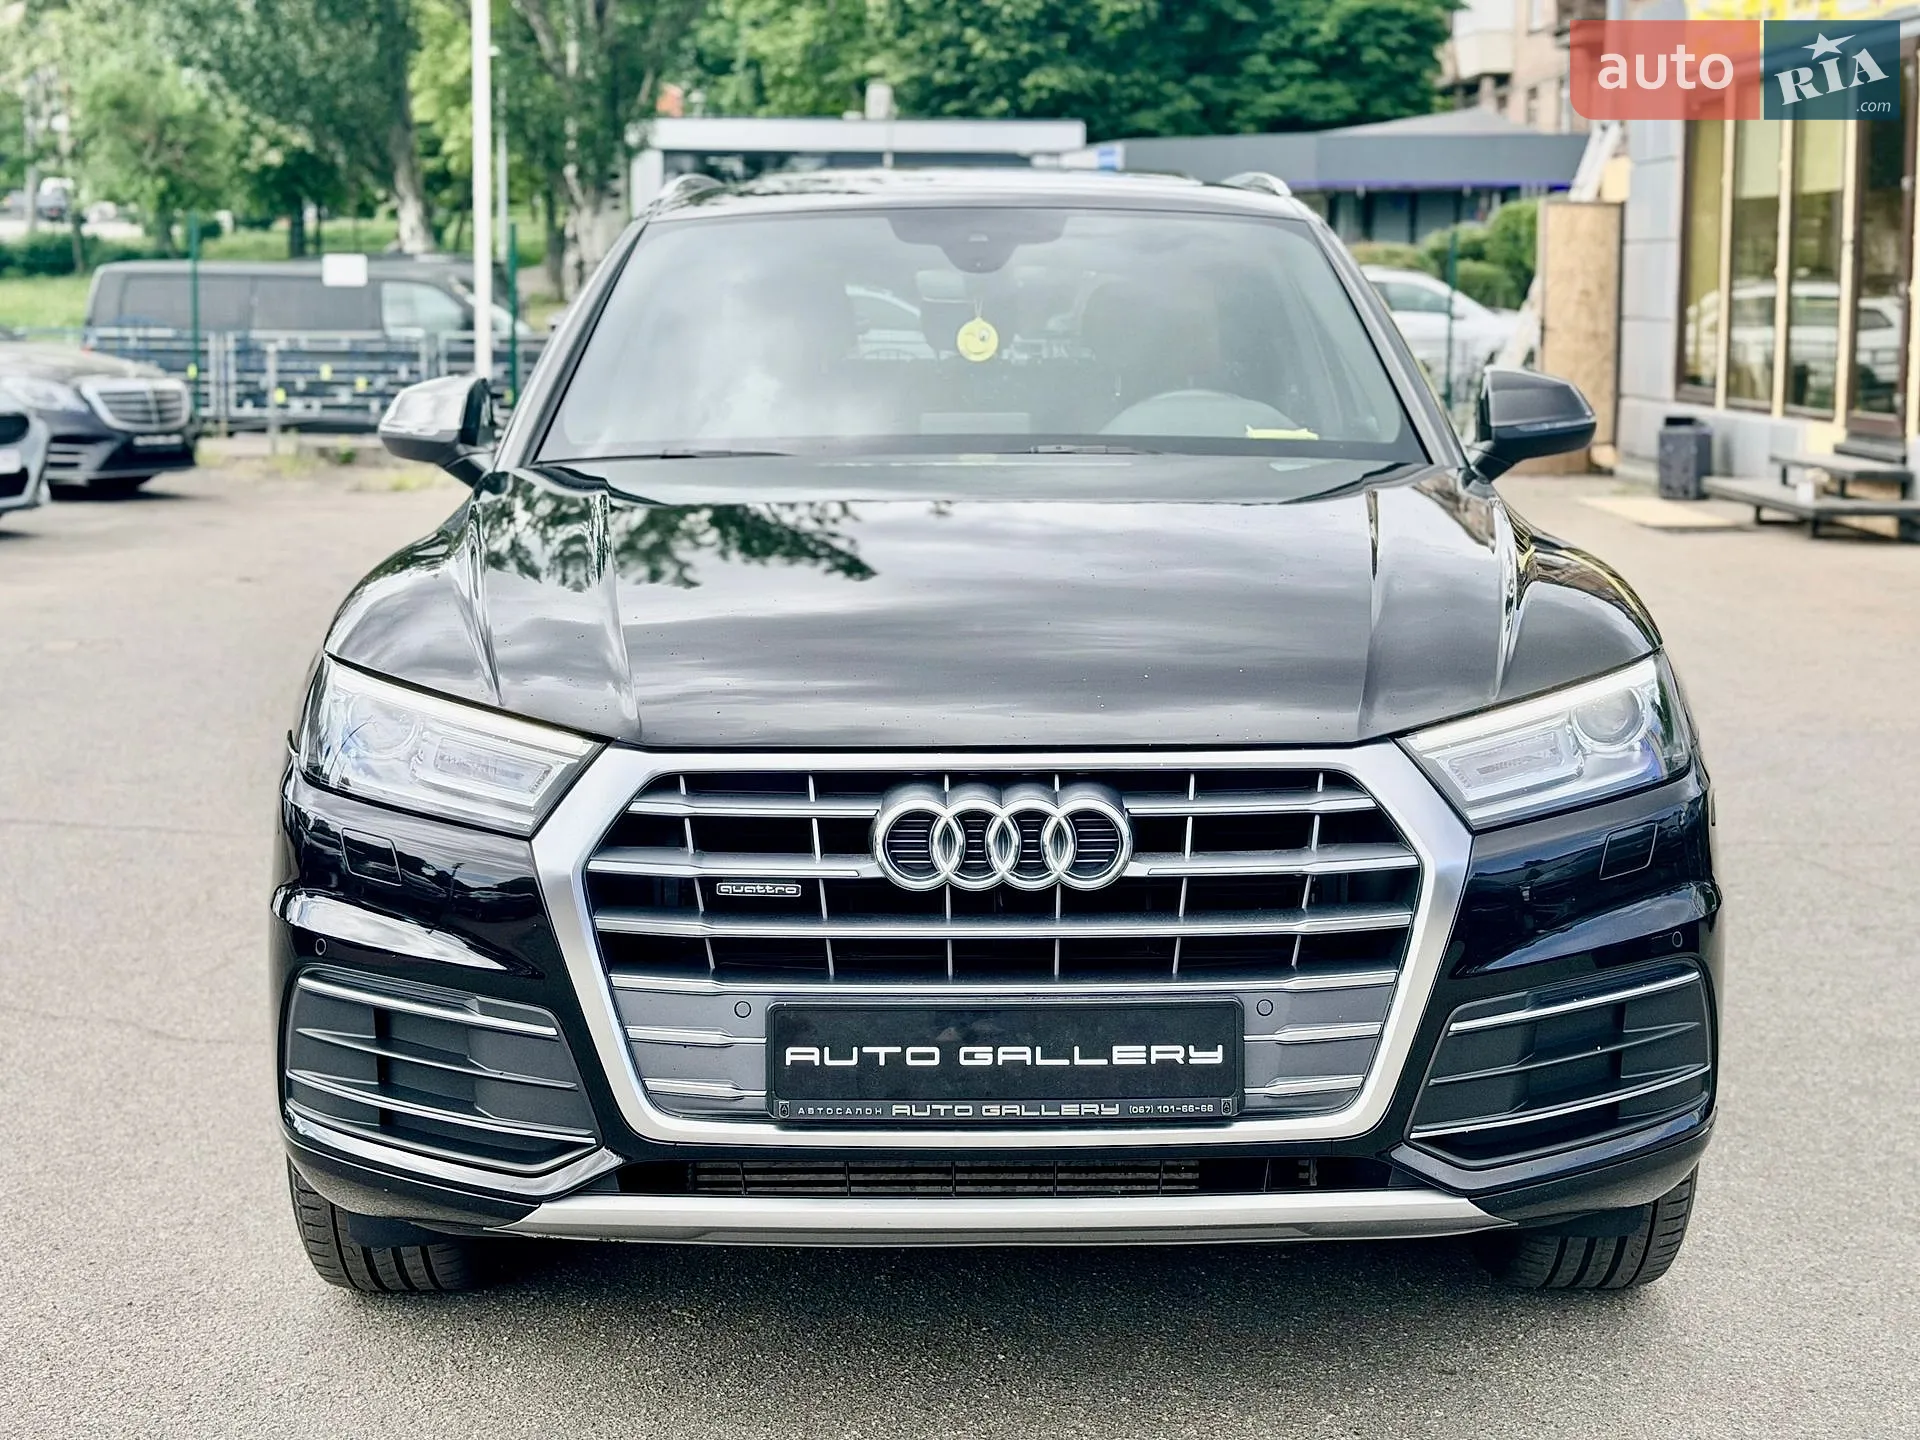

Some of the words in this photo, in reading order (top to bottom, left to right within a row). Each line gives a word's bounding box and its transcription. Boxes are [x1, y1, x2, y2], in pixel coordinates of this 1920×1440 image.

[720, 885, 797, 894] quattro
[785, 1046, 940, 1066] AUTO
[959, 1044, 1223, 1066] GALLERY
[892, 1104, 973, 1117] AUTO
[981, 1103, 1120, 1117] GALLERY
